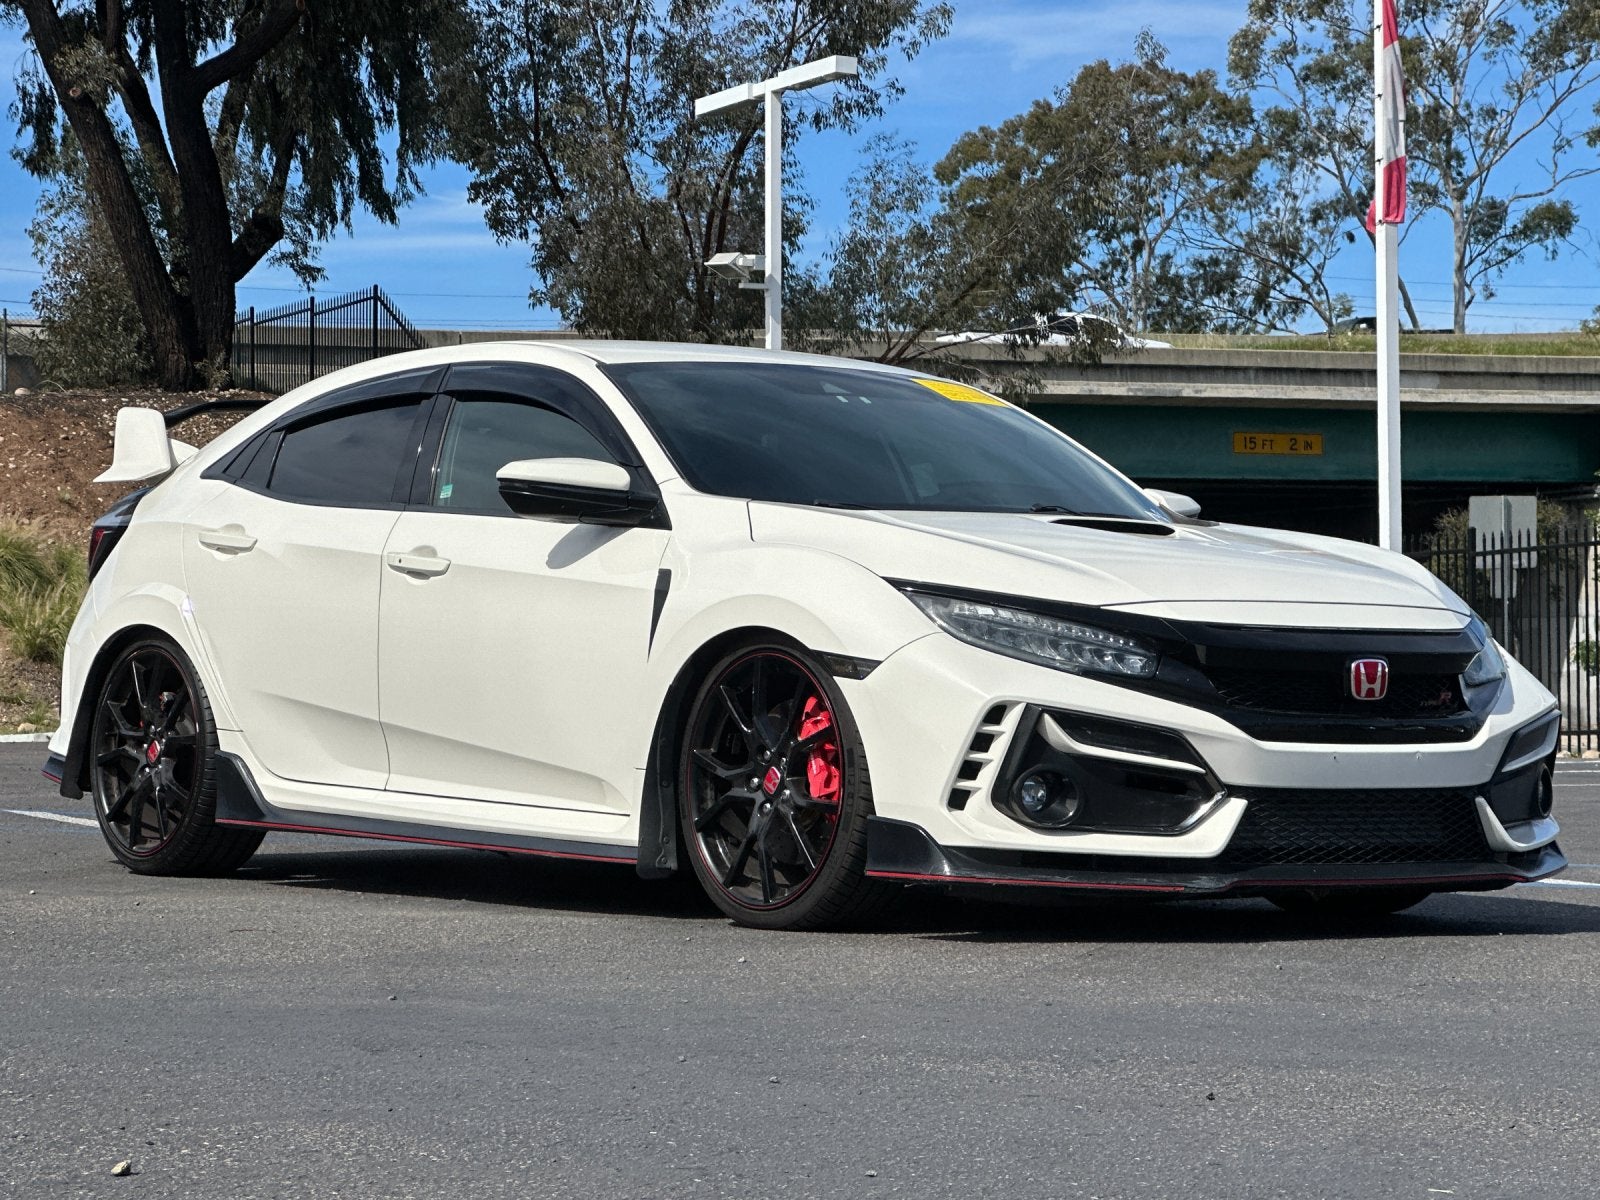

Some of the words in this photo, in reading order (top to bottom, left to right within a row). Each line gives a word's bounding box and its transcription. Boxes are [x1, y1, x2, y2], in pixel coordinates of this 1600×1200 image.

[1243, 436, 1257, 450] 15
[1261, 439, 1274, 450] FT
[1289, 437, 1298, 451] 2
[1303, 440, 1313, 451] IN
